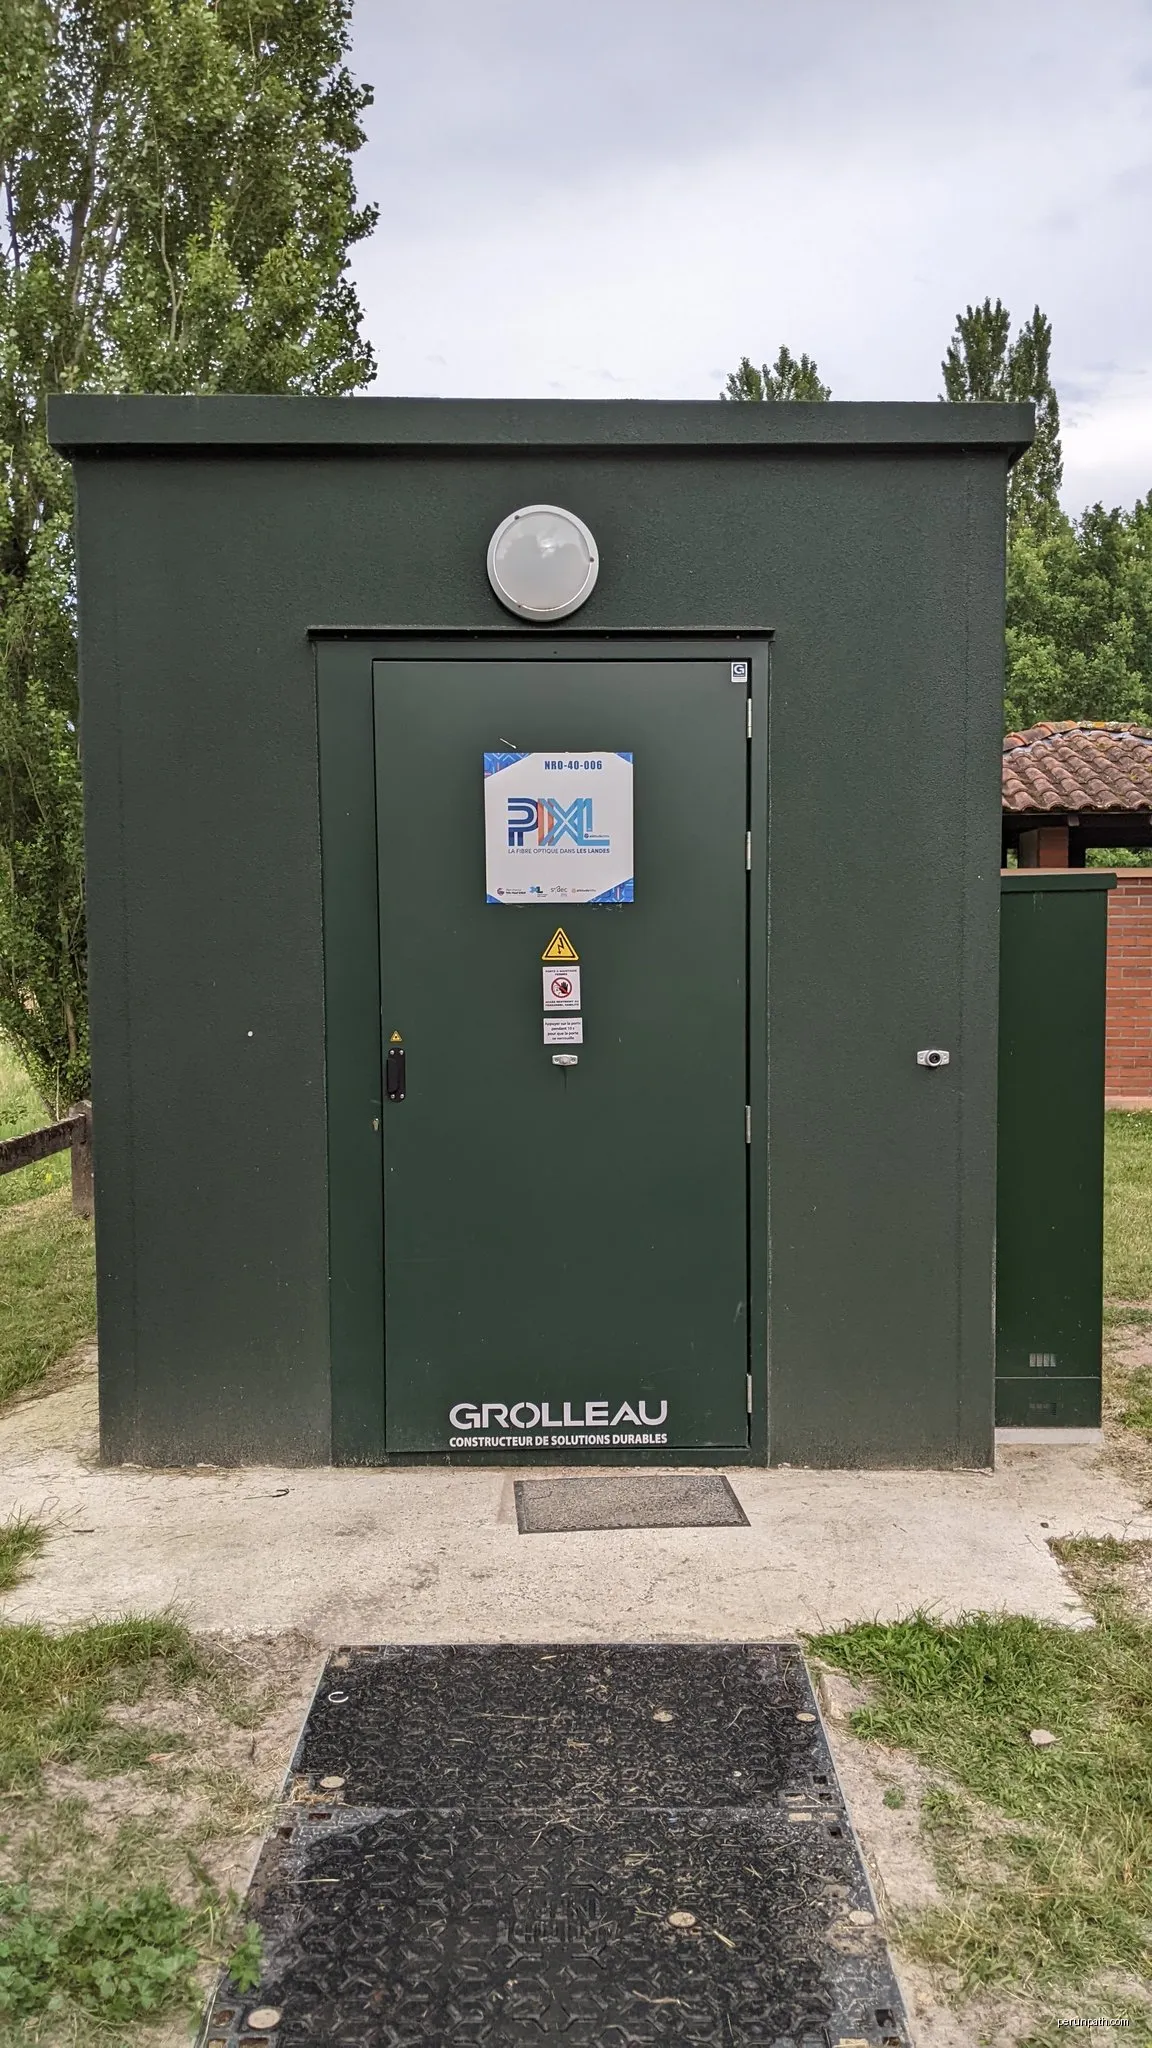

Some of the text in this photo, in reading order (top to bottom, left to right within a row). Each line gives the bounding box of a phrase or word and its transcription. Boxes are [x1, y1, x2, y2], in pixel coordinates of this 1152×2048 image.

[449, 1399, 668, 1430] GROLLEAU
[449, 1433, 668, 1448] CONSTRUCTEUR DE SOLUTIONS DURABLES
